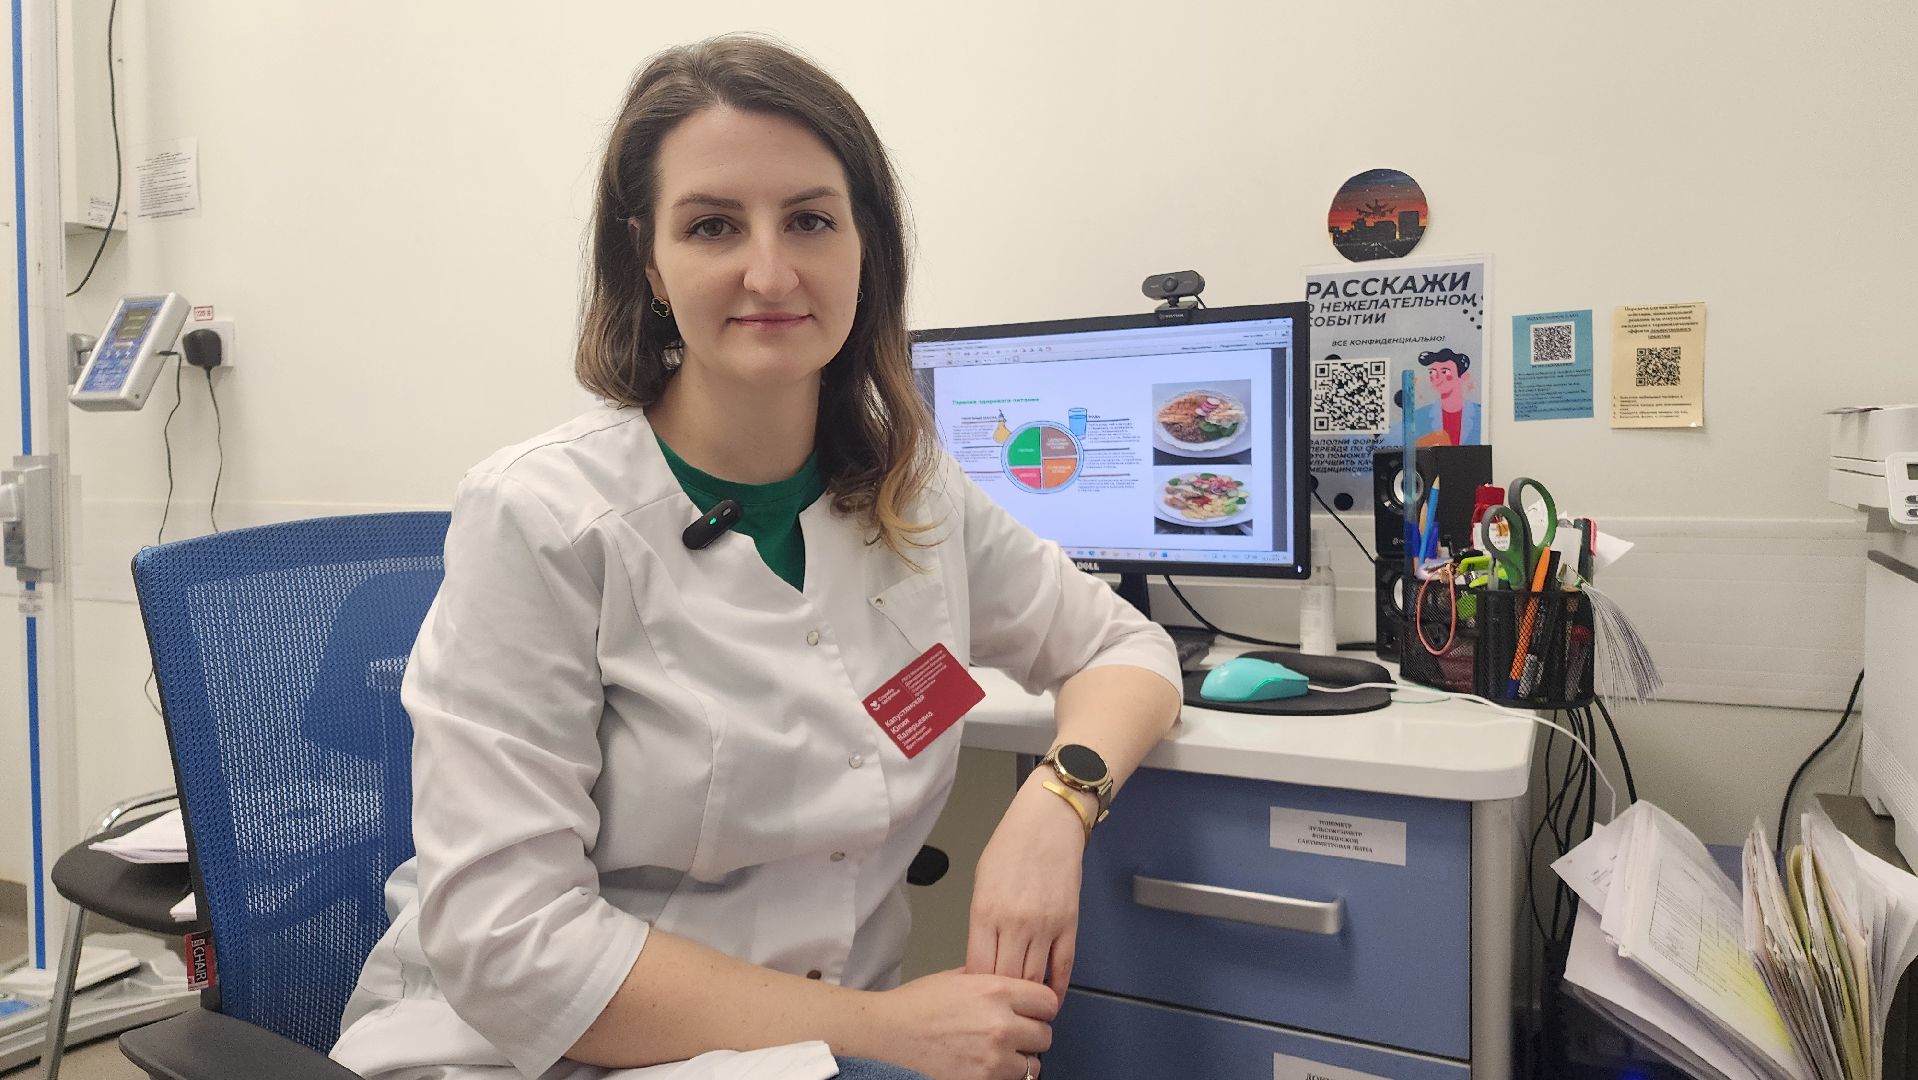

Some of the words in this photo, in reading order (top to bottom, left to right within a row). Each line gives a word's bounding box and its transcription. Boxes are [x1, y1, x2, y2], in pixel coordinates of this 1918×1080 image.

[1306, 271, 1470, 300] РАССКАЖИ
[1320, 293, 1476, 313] НЕЖЕЛАТЕЛЬНОМ
[1349, 336, 1446, 347] КОНФИДЕНЦИАЛЬНО!
[1076, 562, 1100, 571] DELL
[890, 718, 910, 734] Юлия
[896, 711, 934, 740] Валерьевна
[193, 946, 207, 981] CHAIR
